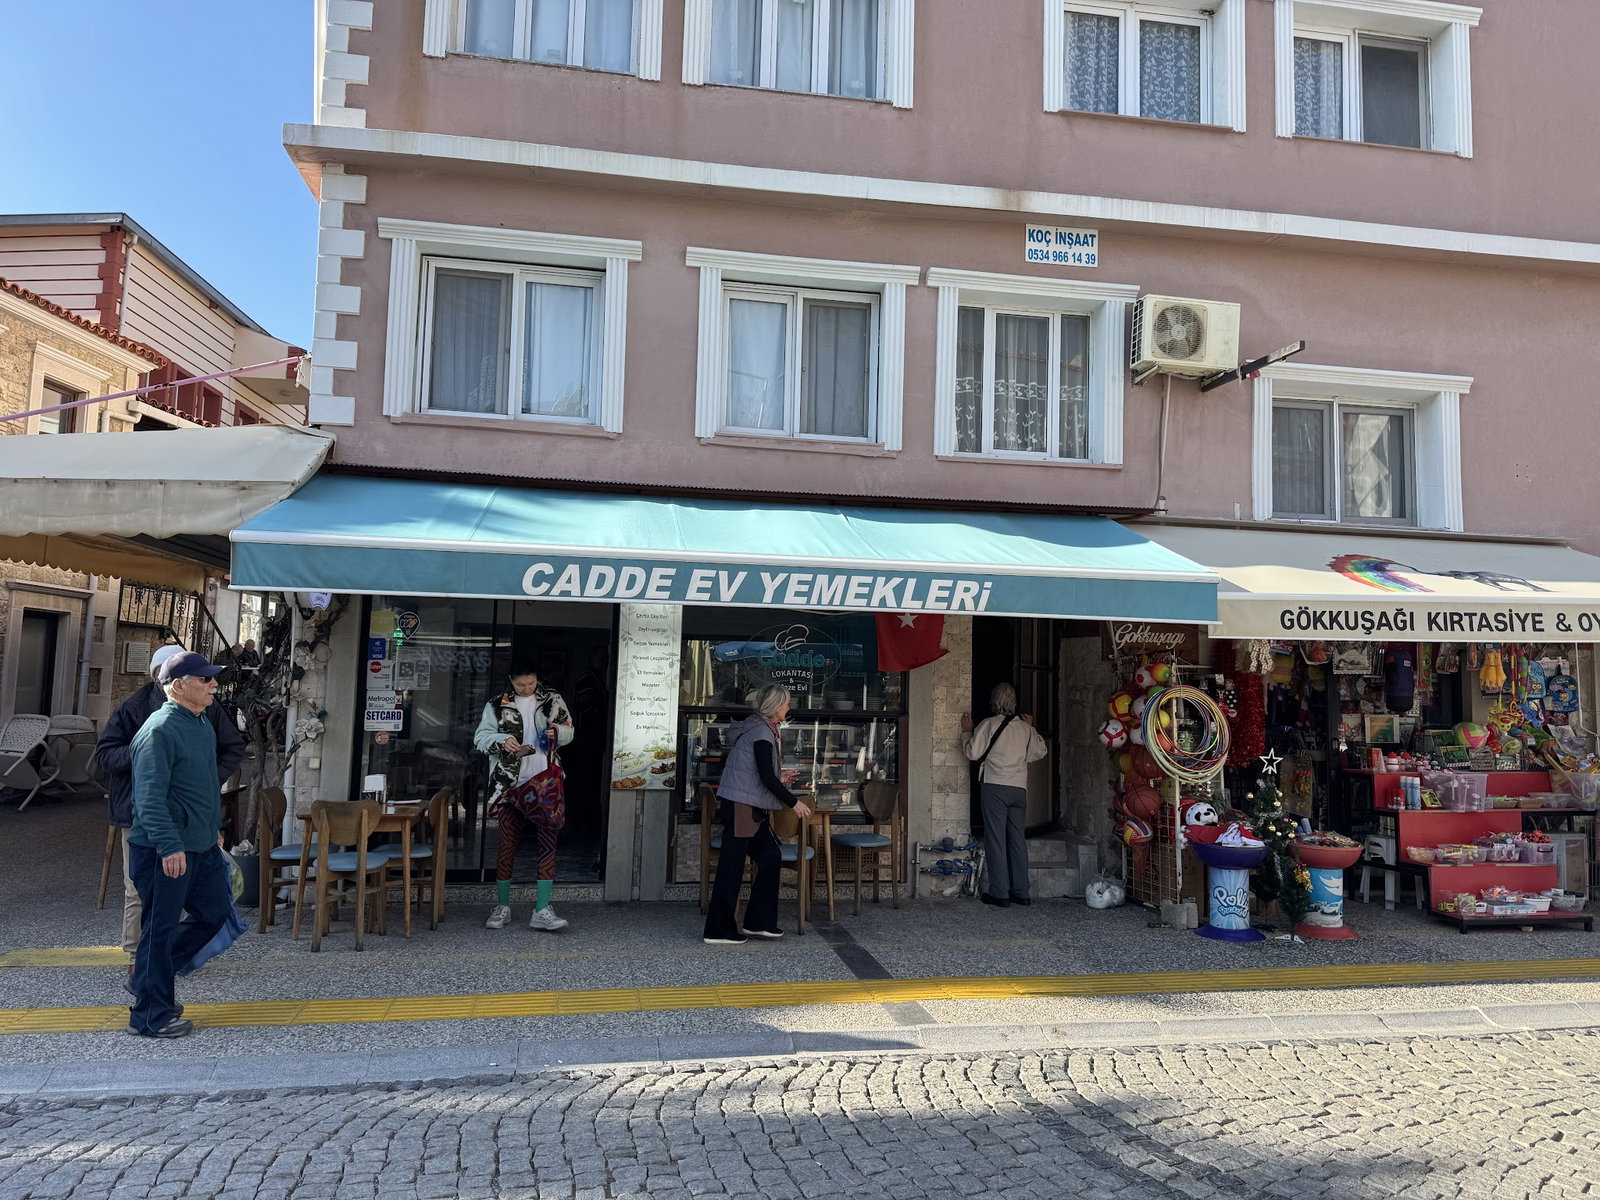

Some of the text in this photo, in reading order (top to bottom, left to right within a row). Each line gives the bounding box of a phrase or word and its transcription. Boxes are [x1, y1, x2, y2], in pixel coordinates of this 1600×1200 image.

[1028, 228, 1096, 249] KOÇ İNŞAAT
[1028, 248, 1096, 265] 0534 966 14 39
[521, 562, 676, 599] CADDE
[684, 568, 749, 602] EV
[1280, 606, 1415, 635] GÖKKUŞAĞI
[1427, 608, 1545, 633] KIRTASİYE
[1555, 612, 1572, 633] &
[757, 649, 825, 668] Cadde
[771, 669, 814, 679] LOKANTASI
[797, 683, 808, 691] Evi
[367, 695, 396, 703] Metropol
[366, 711, 402, 721] SETCARD
